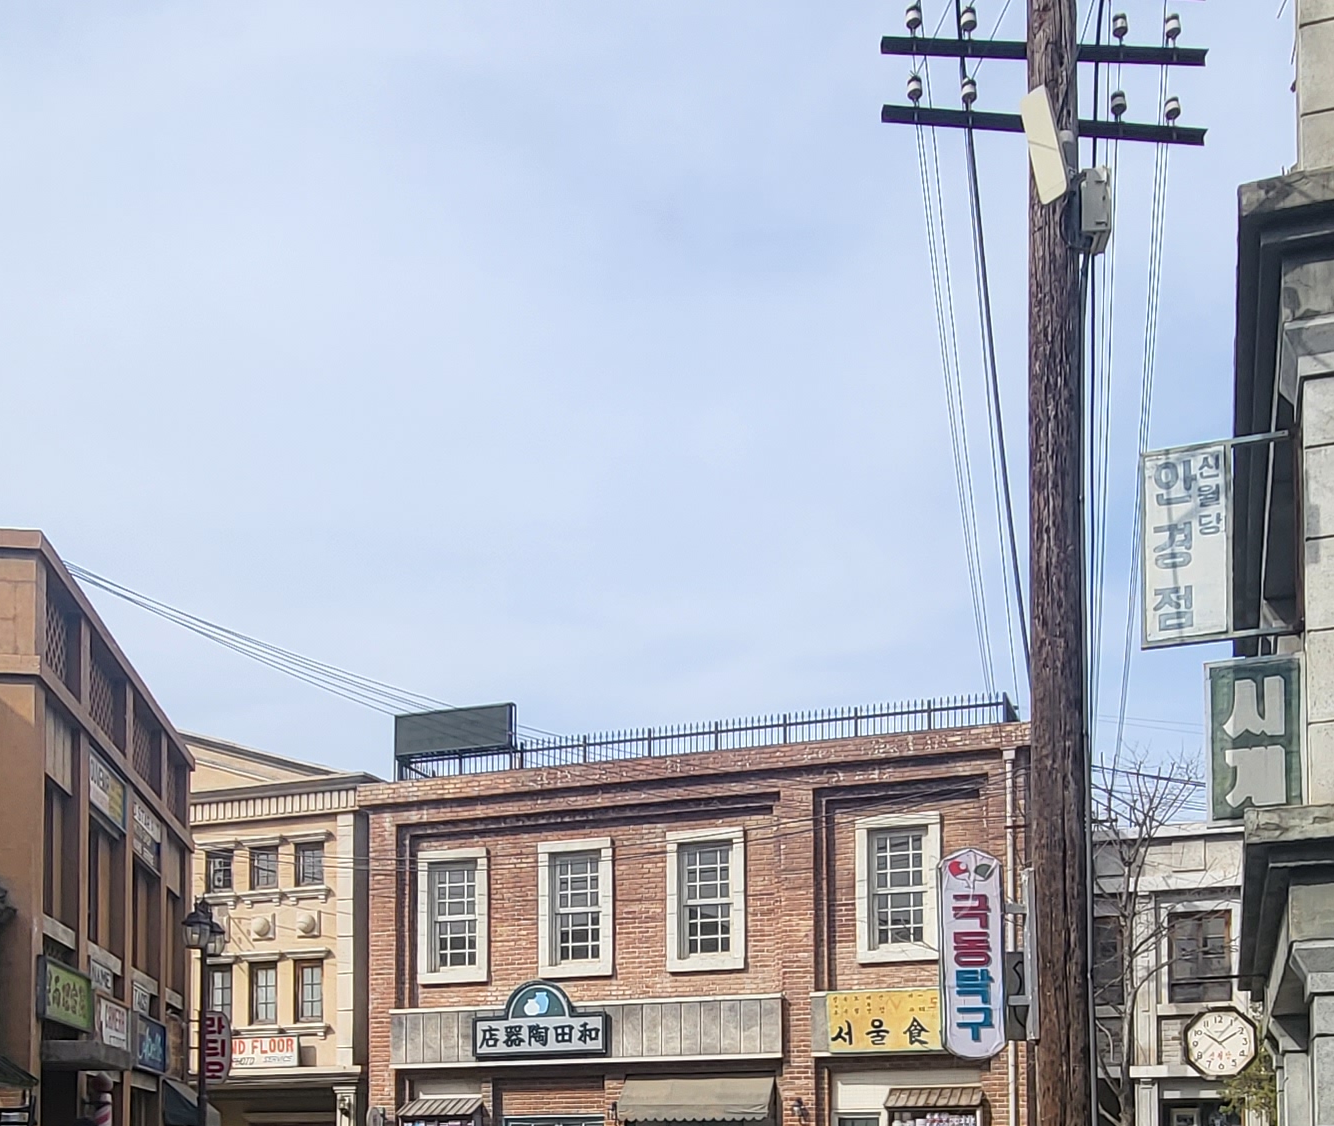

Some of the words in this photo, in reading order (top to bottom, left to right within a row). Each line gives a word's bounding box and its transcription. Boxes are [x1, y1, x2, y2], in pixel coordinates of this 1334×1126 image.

[1197, 453, 1222, 535] 신월당
[1153, 459, 1196, 632] 안경점
[251, 1038, 294, 1055] FLOOR
